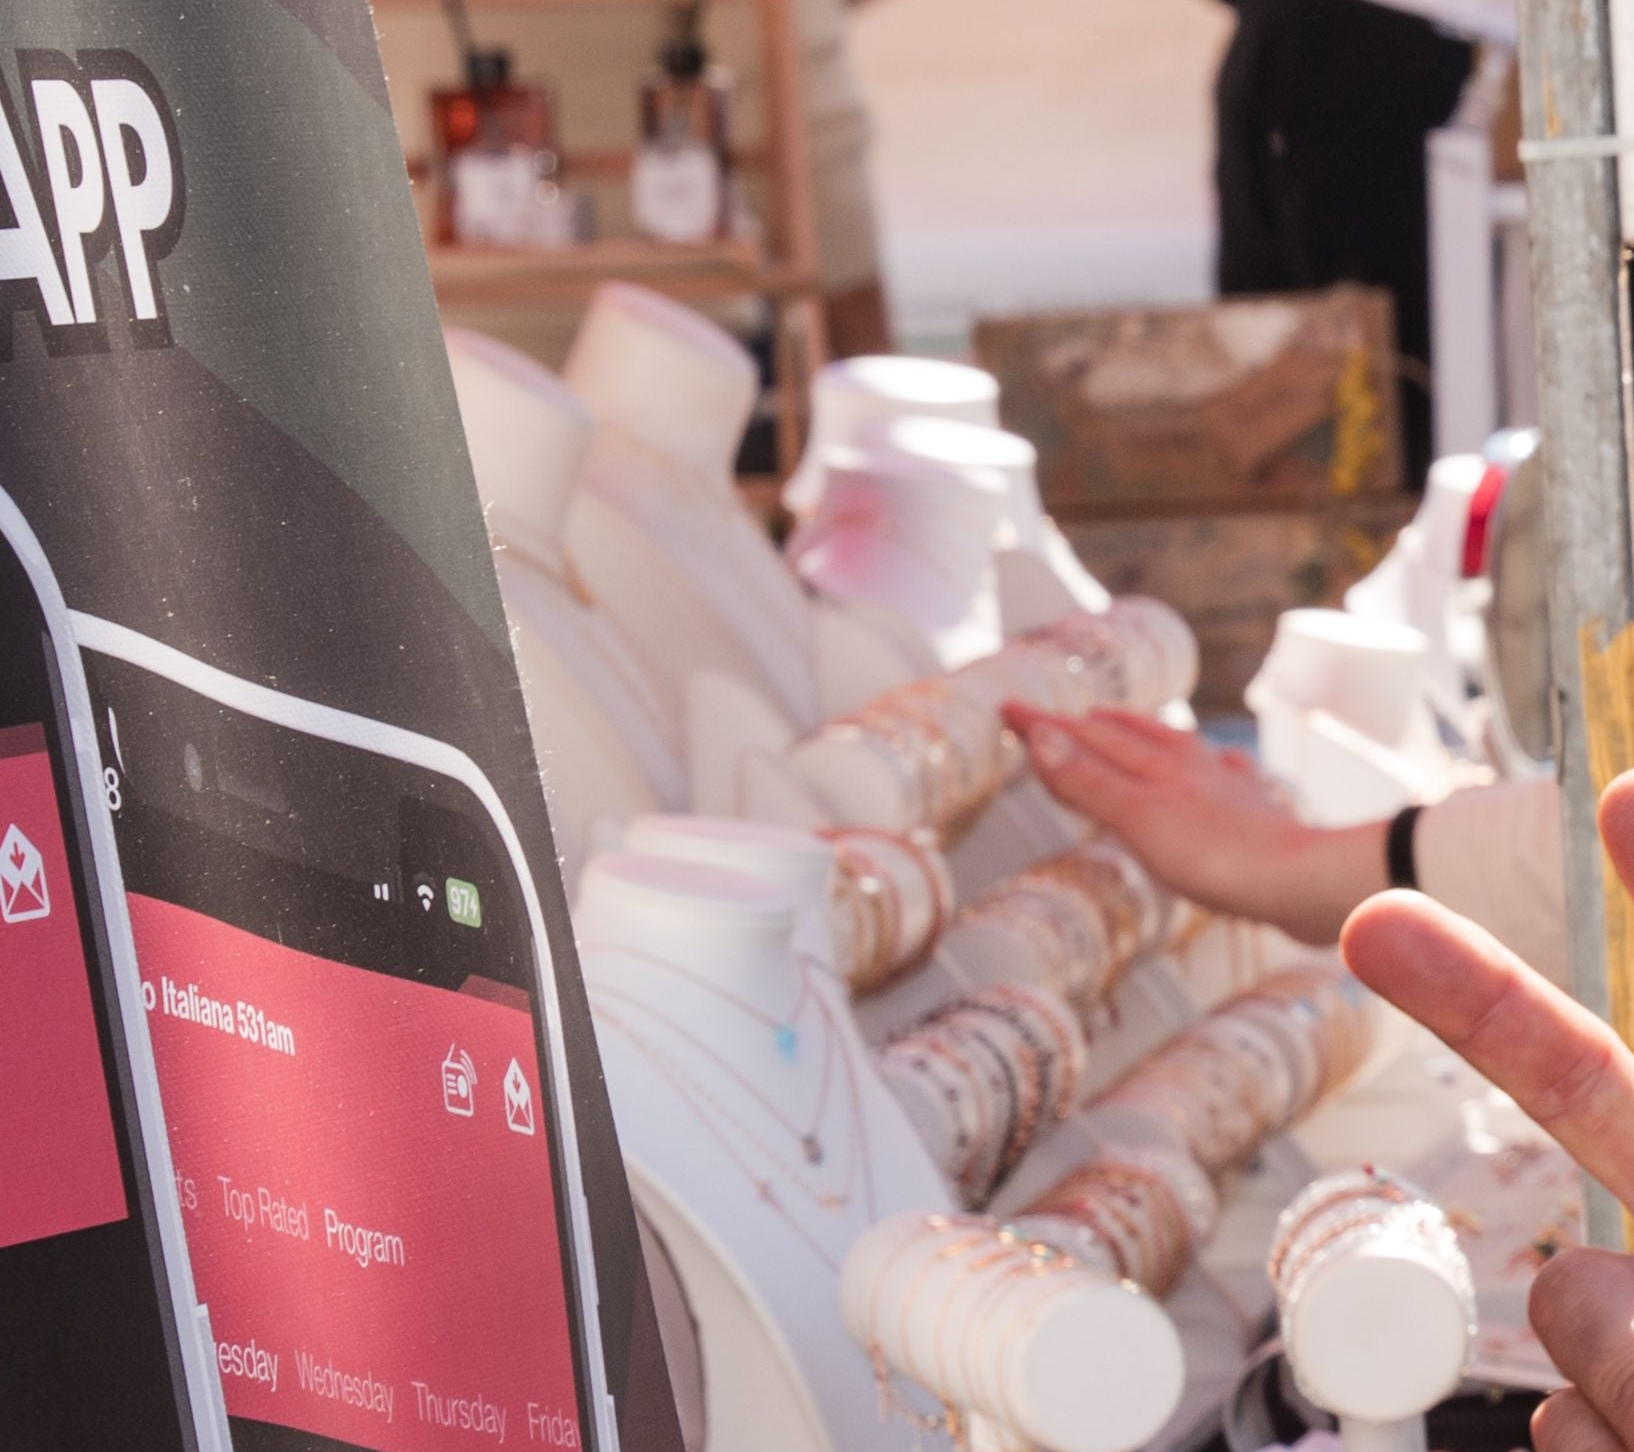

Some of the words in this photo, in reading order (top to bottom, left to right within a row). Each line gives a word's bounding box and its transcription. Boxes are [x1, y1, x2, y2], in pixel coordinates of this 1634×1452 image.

[161, 975, 235, 1035] Italiana
[236, 1000, 296, 1056] 531am
[217, 1175, 255, 1232] Top
[258, 1187, 310, 1240] Rated
[323, 1208, 405, 1268] Program
[214, 1339, 278, 1392] esday
[295, 1347, 394, 1424] Wednesday
[411, 1381, 507, 1444] Thursday
